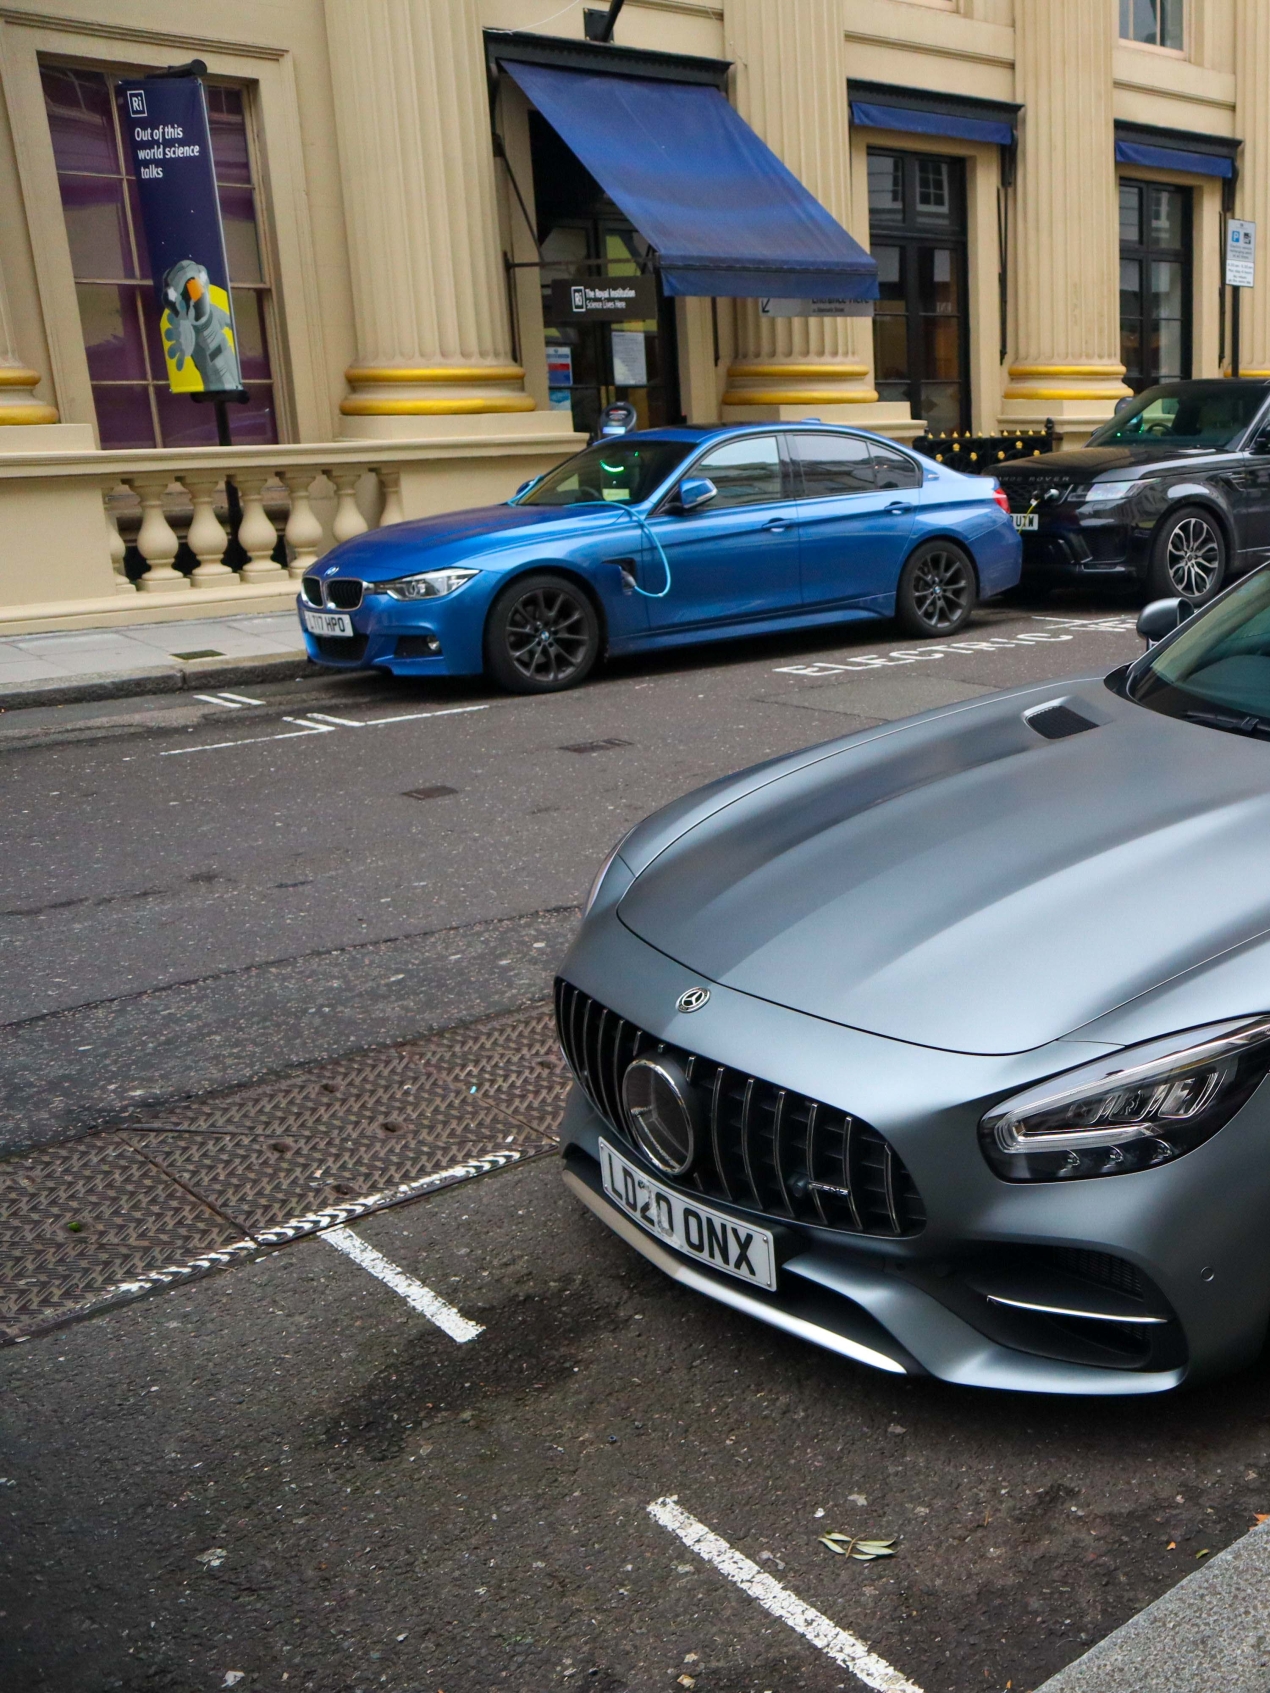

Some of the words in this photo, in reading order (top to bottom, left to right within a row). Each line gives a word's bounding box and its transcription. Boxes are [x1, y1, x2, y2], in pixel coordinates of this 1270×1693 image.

[132, 97, 143, 111] Ri
[134, 127, 152, 141] Out
[153, 125, 163, 143] of
[164, 124, 183, 139] this
[137, 144, 164, 160] world
[165, 143, 200, 158] science
[140, 164, 163, 179] talks
[585, 288, 595, 298] The
[595, 288, 609, 300] Royal
[610, 287, 636, 298] Institution
[586, 300, 602, 309] Science
[602, 300, 615, 309] Lives
[615, 300, 626, 309] Here
[608, 1152, 675, 1238] LD20
[682, 1206, 756, 1277] ONX
